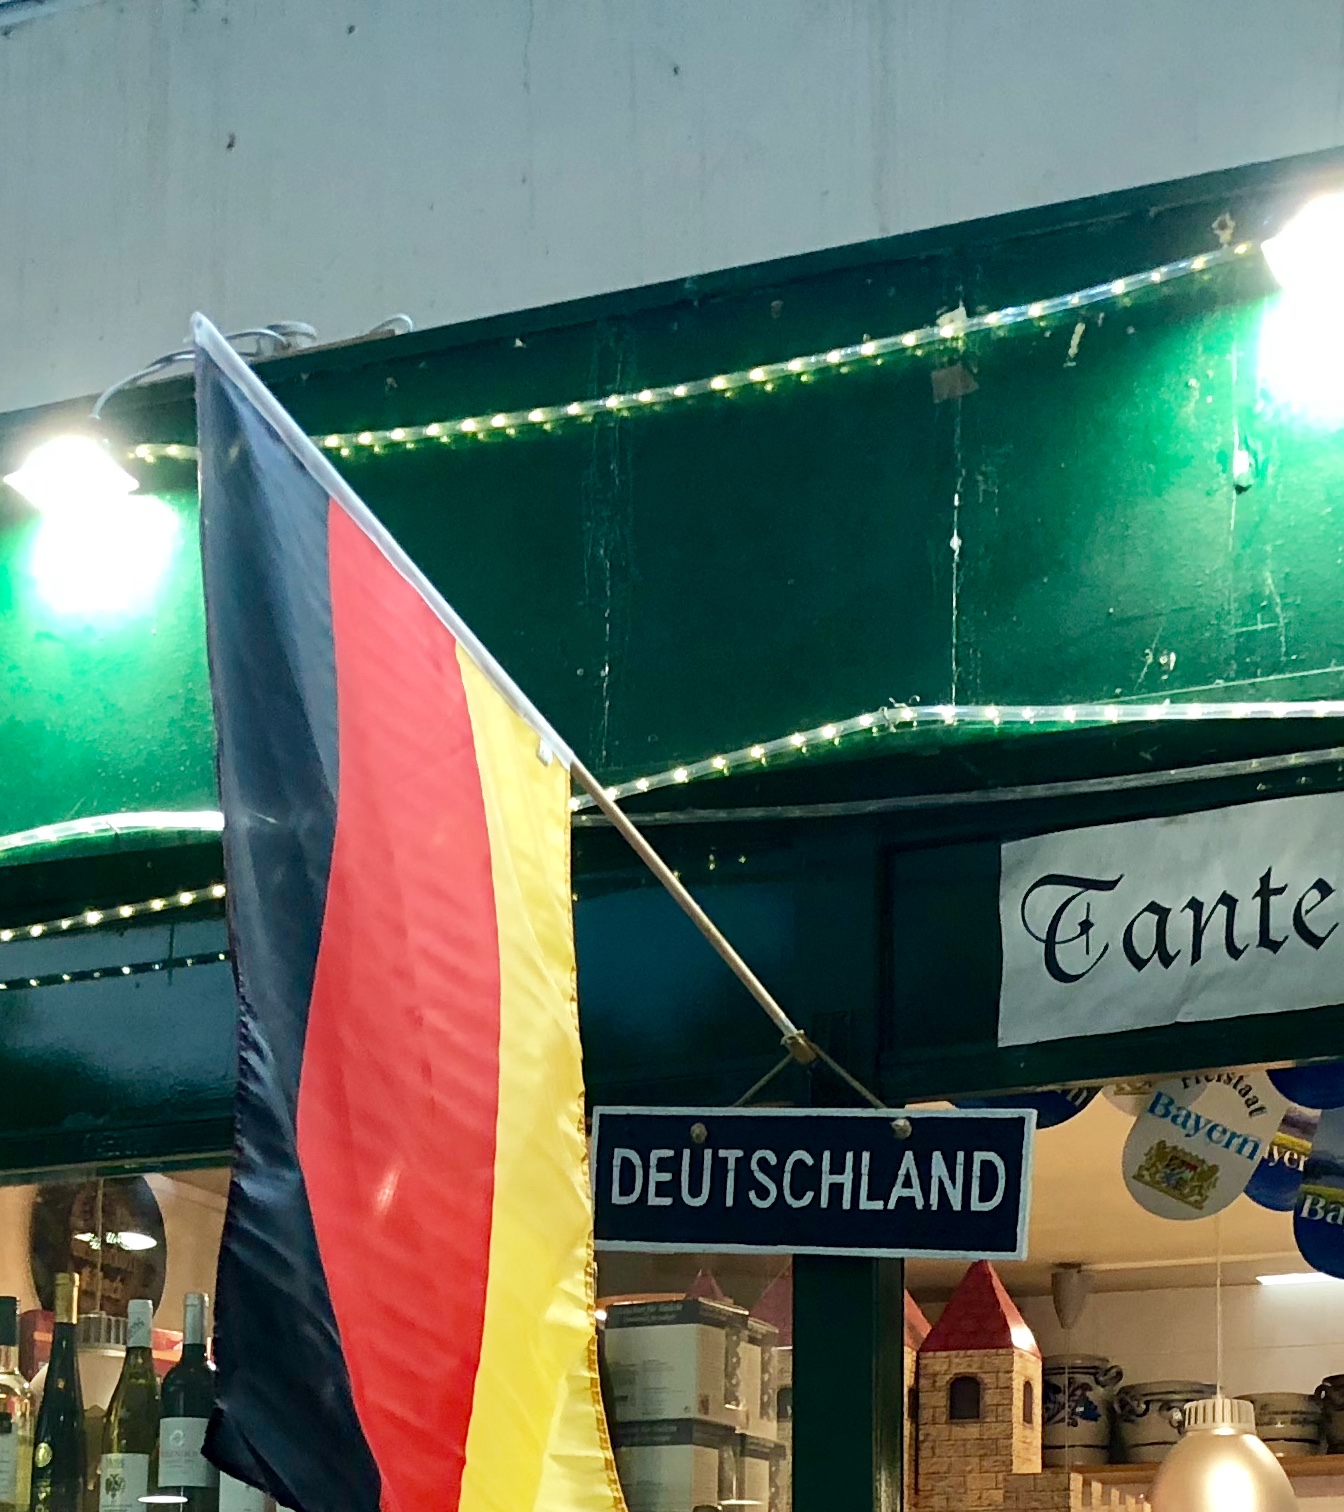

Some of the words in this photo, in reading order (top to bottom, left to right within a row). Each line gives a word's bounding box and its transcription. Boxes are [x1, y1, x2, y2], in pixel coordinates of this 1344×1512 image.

[1020, 866, 1341, 984] Tante
[1147, 1091, 1262, 1162] Bayern
[610, 1147, 1007, 1212] DEUTSCHLAND
